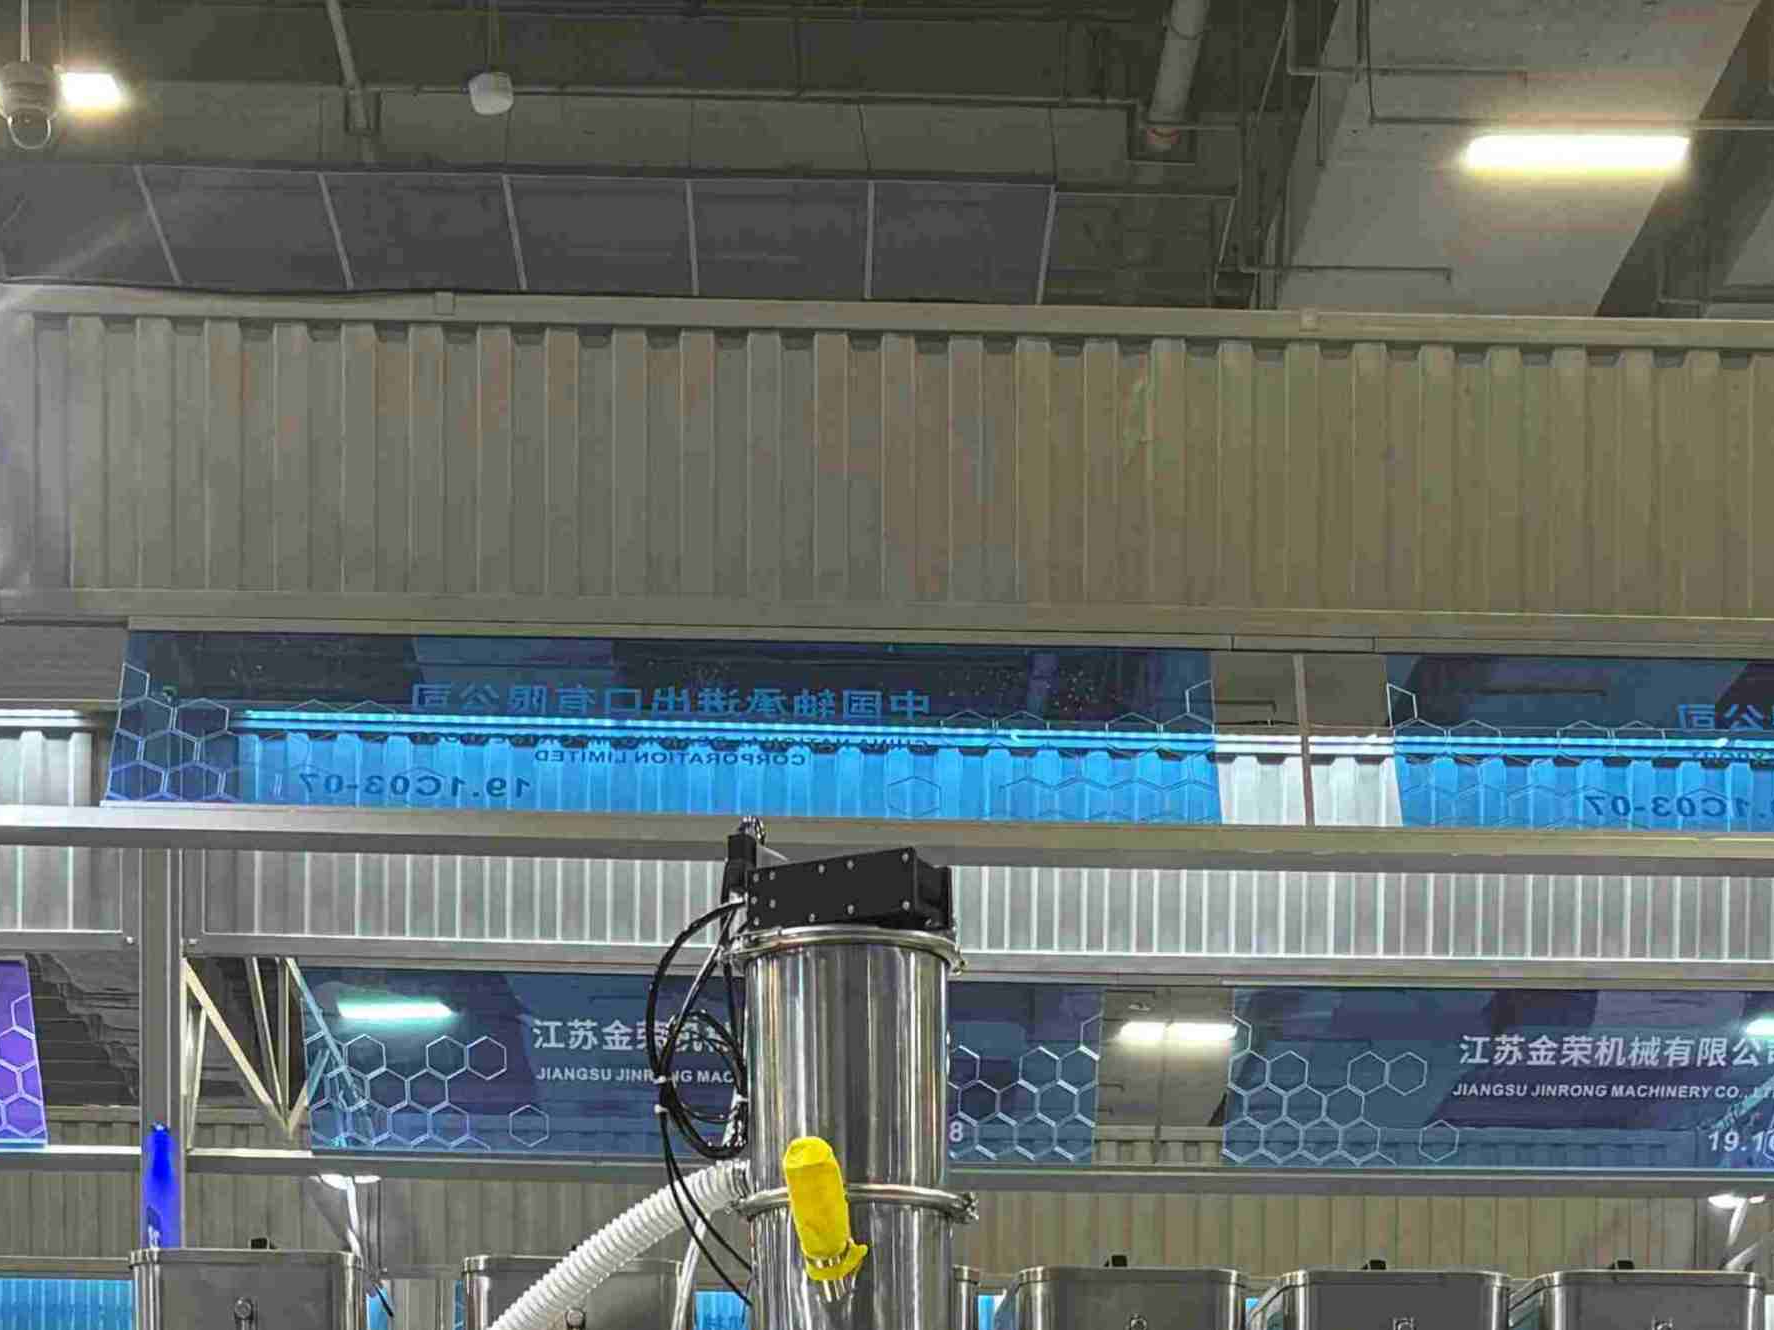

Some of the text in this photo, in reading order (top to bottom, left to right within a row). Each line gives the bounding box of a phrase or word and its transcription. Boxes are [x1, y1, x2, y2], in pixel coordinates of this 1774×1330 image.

[535, 1066, 612, 1082] JIANGSU
[1452, 1082, 1526, 1098] JIANGSU
[1530, 1083, 1607, 1099] JINRONG
[1610, 1083, 1711, 1099] MACHINERY
